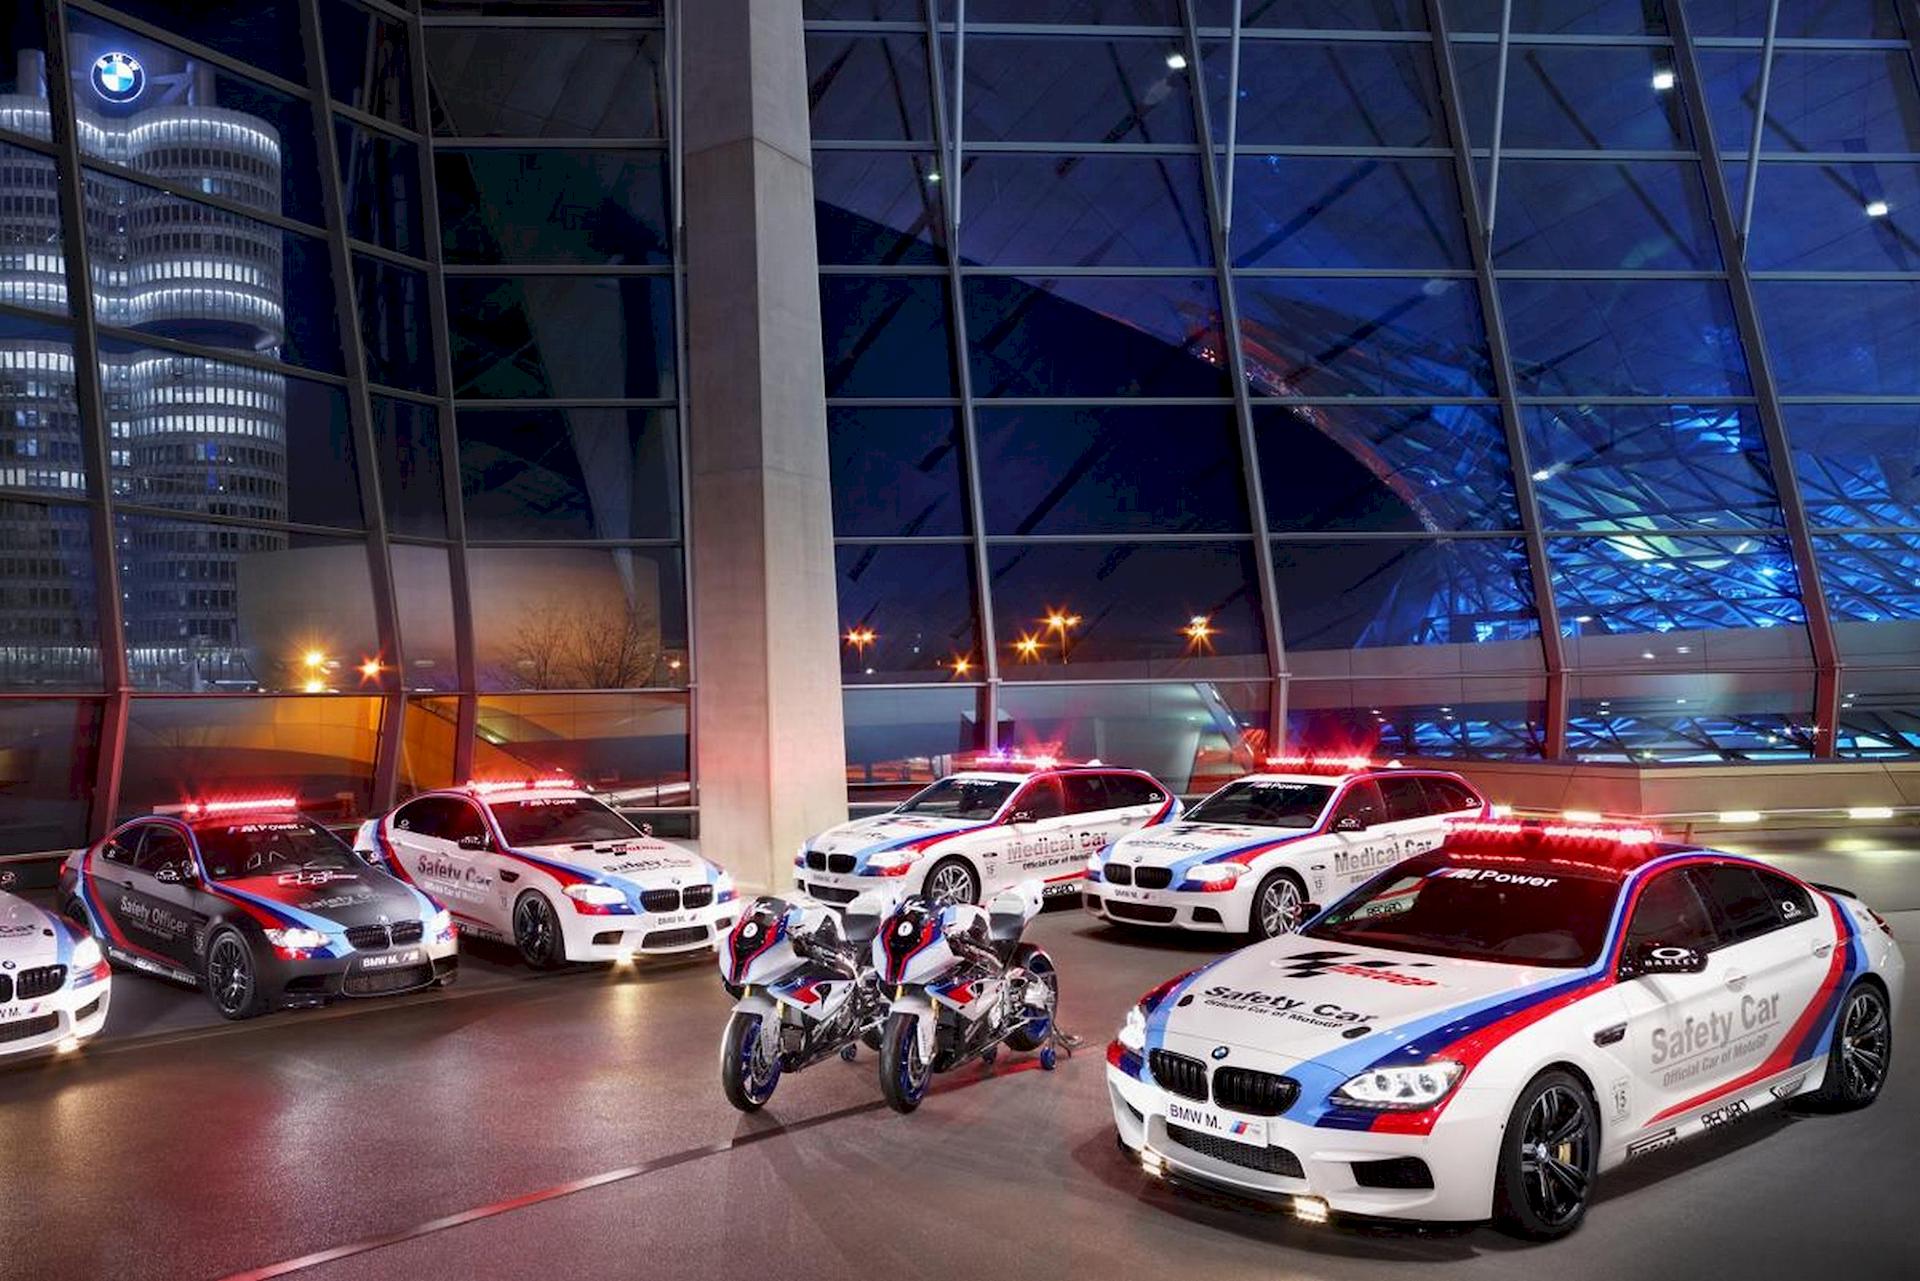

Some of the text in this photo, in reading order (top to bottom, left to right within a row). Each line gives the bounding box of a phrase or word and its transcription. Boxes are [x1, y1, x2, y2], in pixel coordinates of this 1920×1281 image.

[417, 854, 462, 881] Safety
[1334, 842, 1400, 872] Medical
[1478, 869, 1558, 887] Power
[120, 895, 151, 920] Safety
[152, 908, 189, 934] Officer
[1204, 985, 1380, 1024] Safety Car
[1651, 993, 1780, 1065] Safety Car
[1663, 1064, 1700, 1088] Official
[1702, 1054, 1720, 1073] Car
[1721, 1049, 1732, 1063] of
[1169, 1103, 1203, 1126] BMW
[1205, 1113, 1222, 1130] M.
